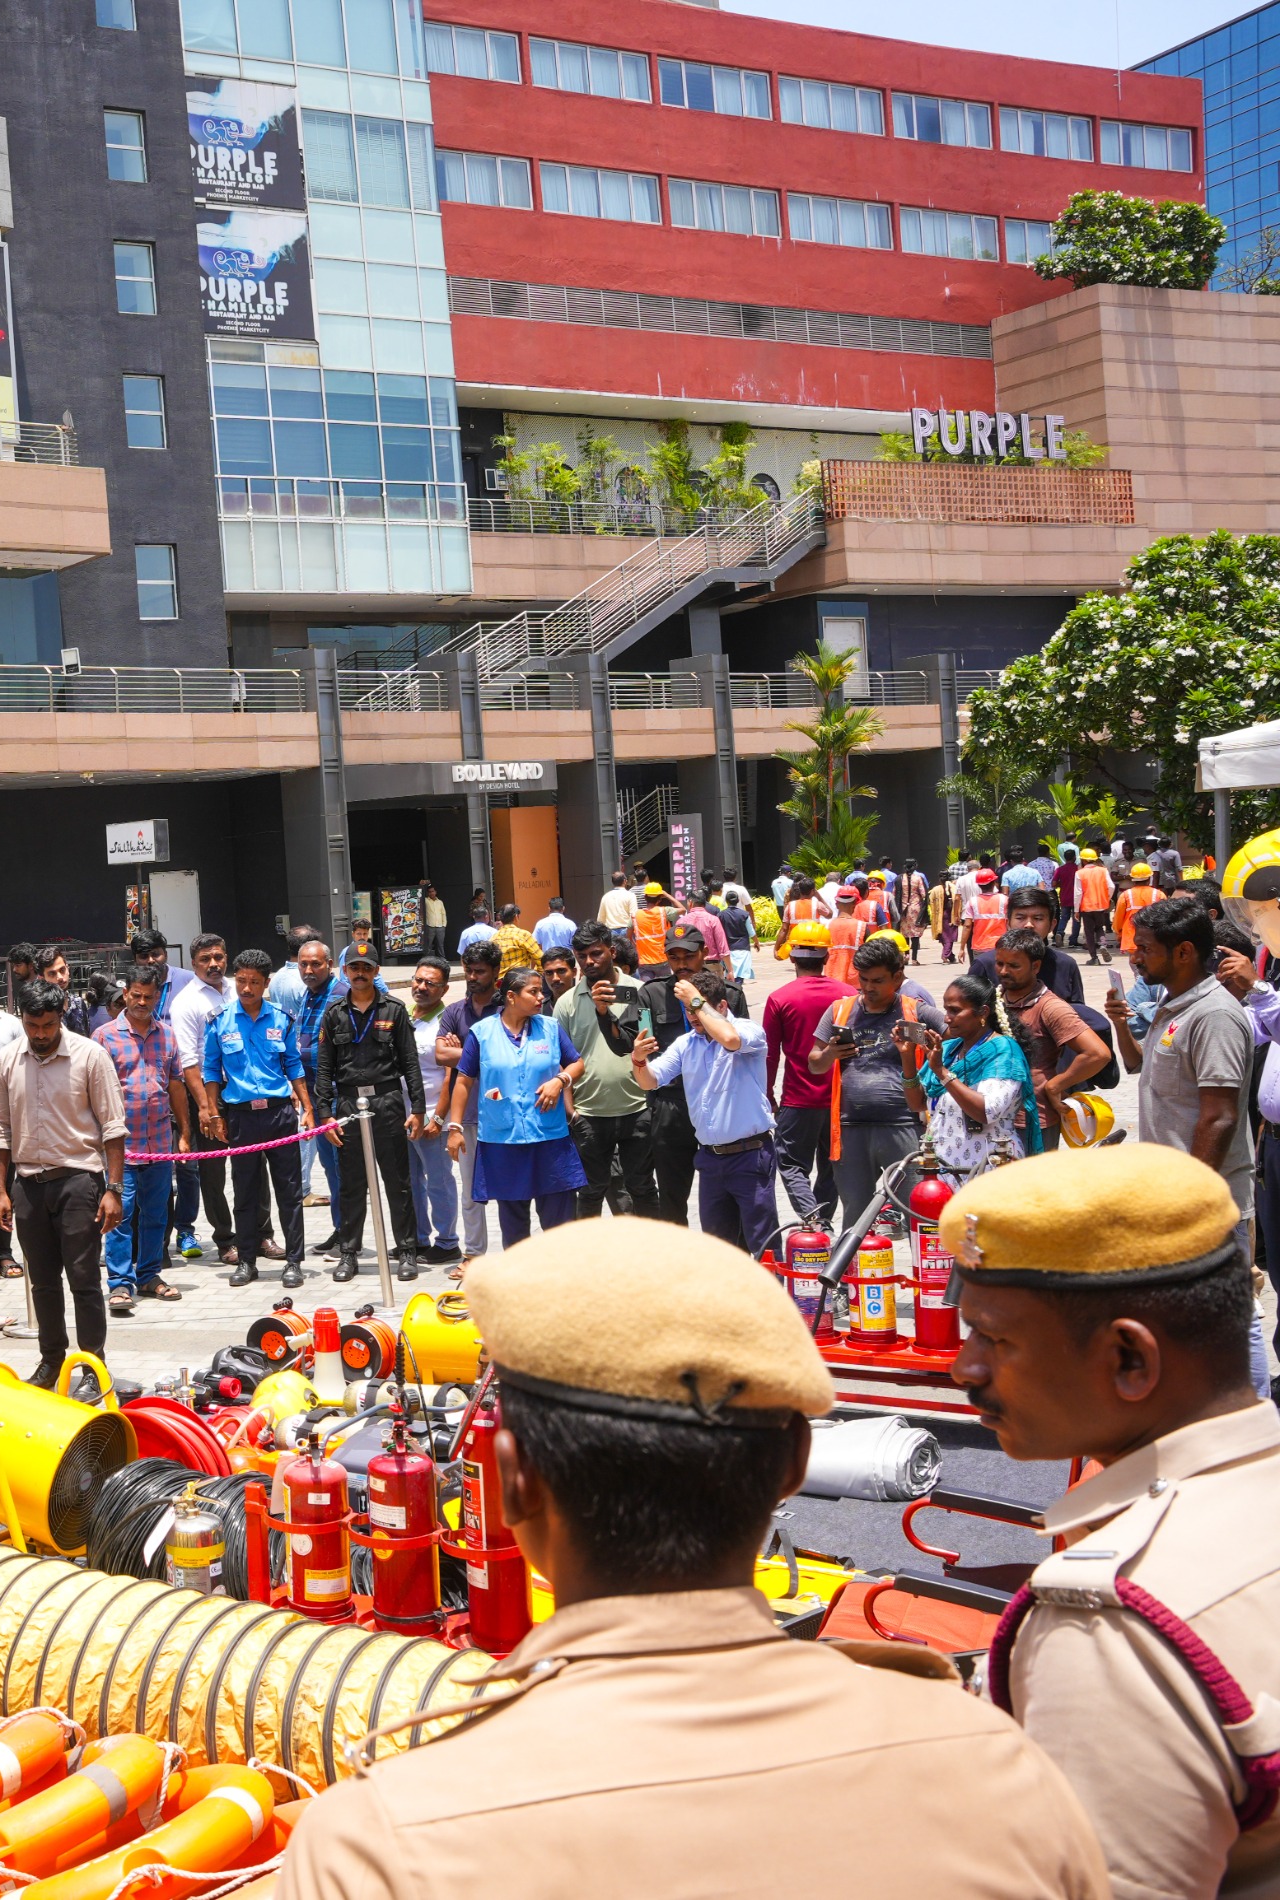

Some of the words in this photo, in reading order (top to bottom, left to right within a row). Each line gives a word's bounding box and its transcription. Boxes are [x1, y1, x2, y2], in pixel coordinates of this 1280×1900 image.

[192, 167, 274, 185] HAMELEON
[198, 178, 236, 188] RESTAURANT
[238, 181, 251, 189] AND
[252, 182, 265, 190] BAR
[209, 311, 246, 319] RESTAURANT
[911, 408, 1067, 459] PURPLE
[452, 762, 543, 782] BOULEVARD
[671, 824, 686, 900] PURPLE
[683, 827, 693, 896] HAMELEON
[518, 880, 551, 888] PALLADIUM
[870, 1288, 878, 1298] B
[870, 1303, 879, 1314] C
